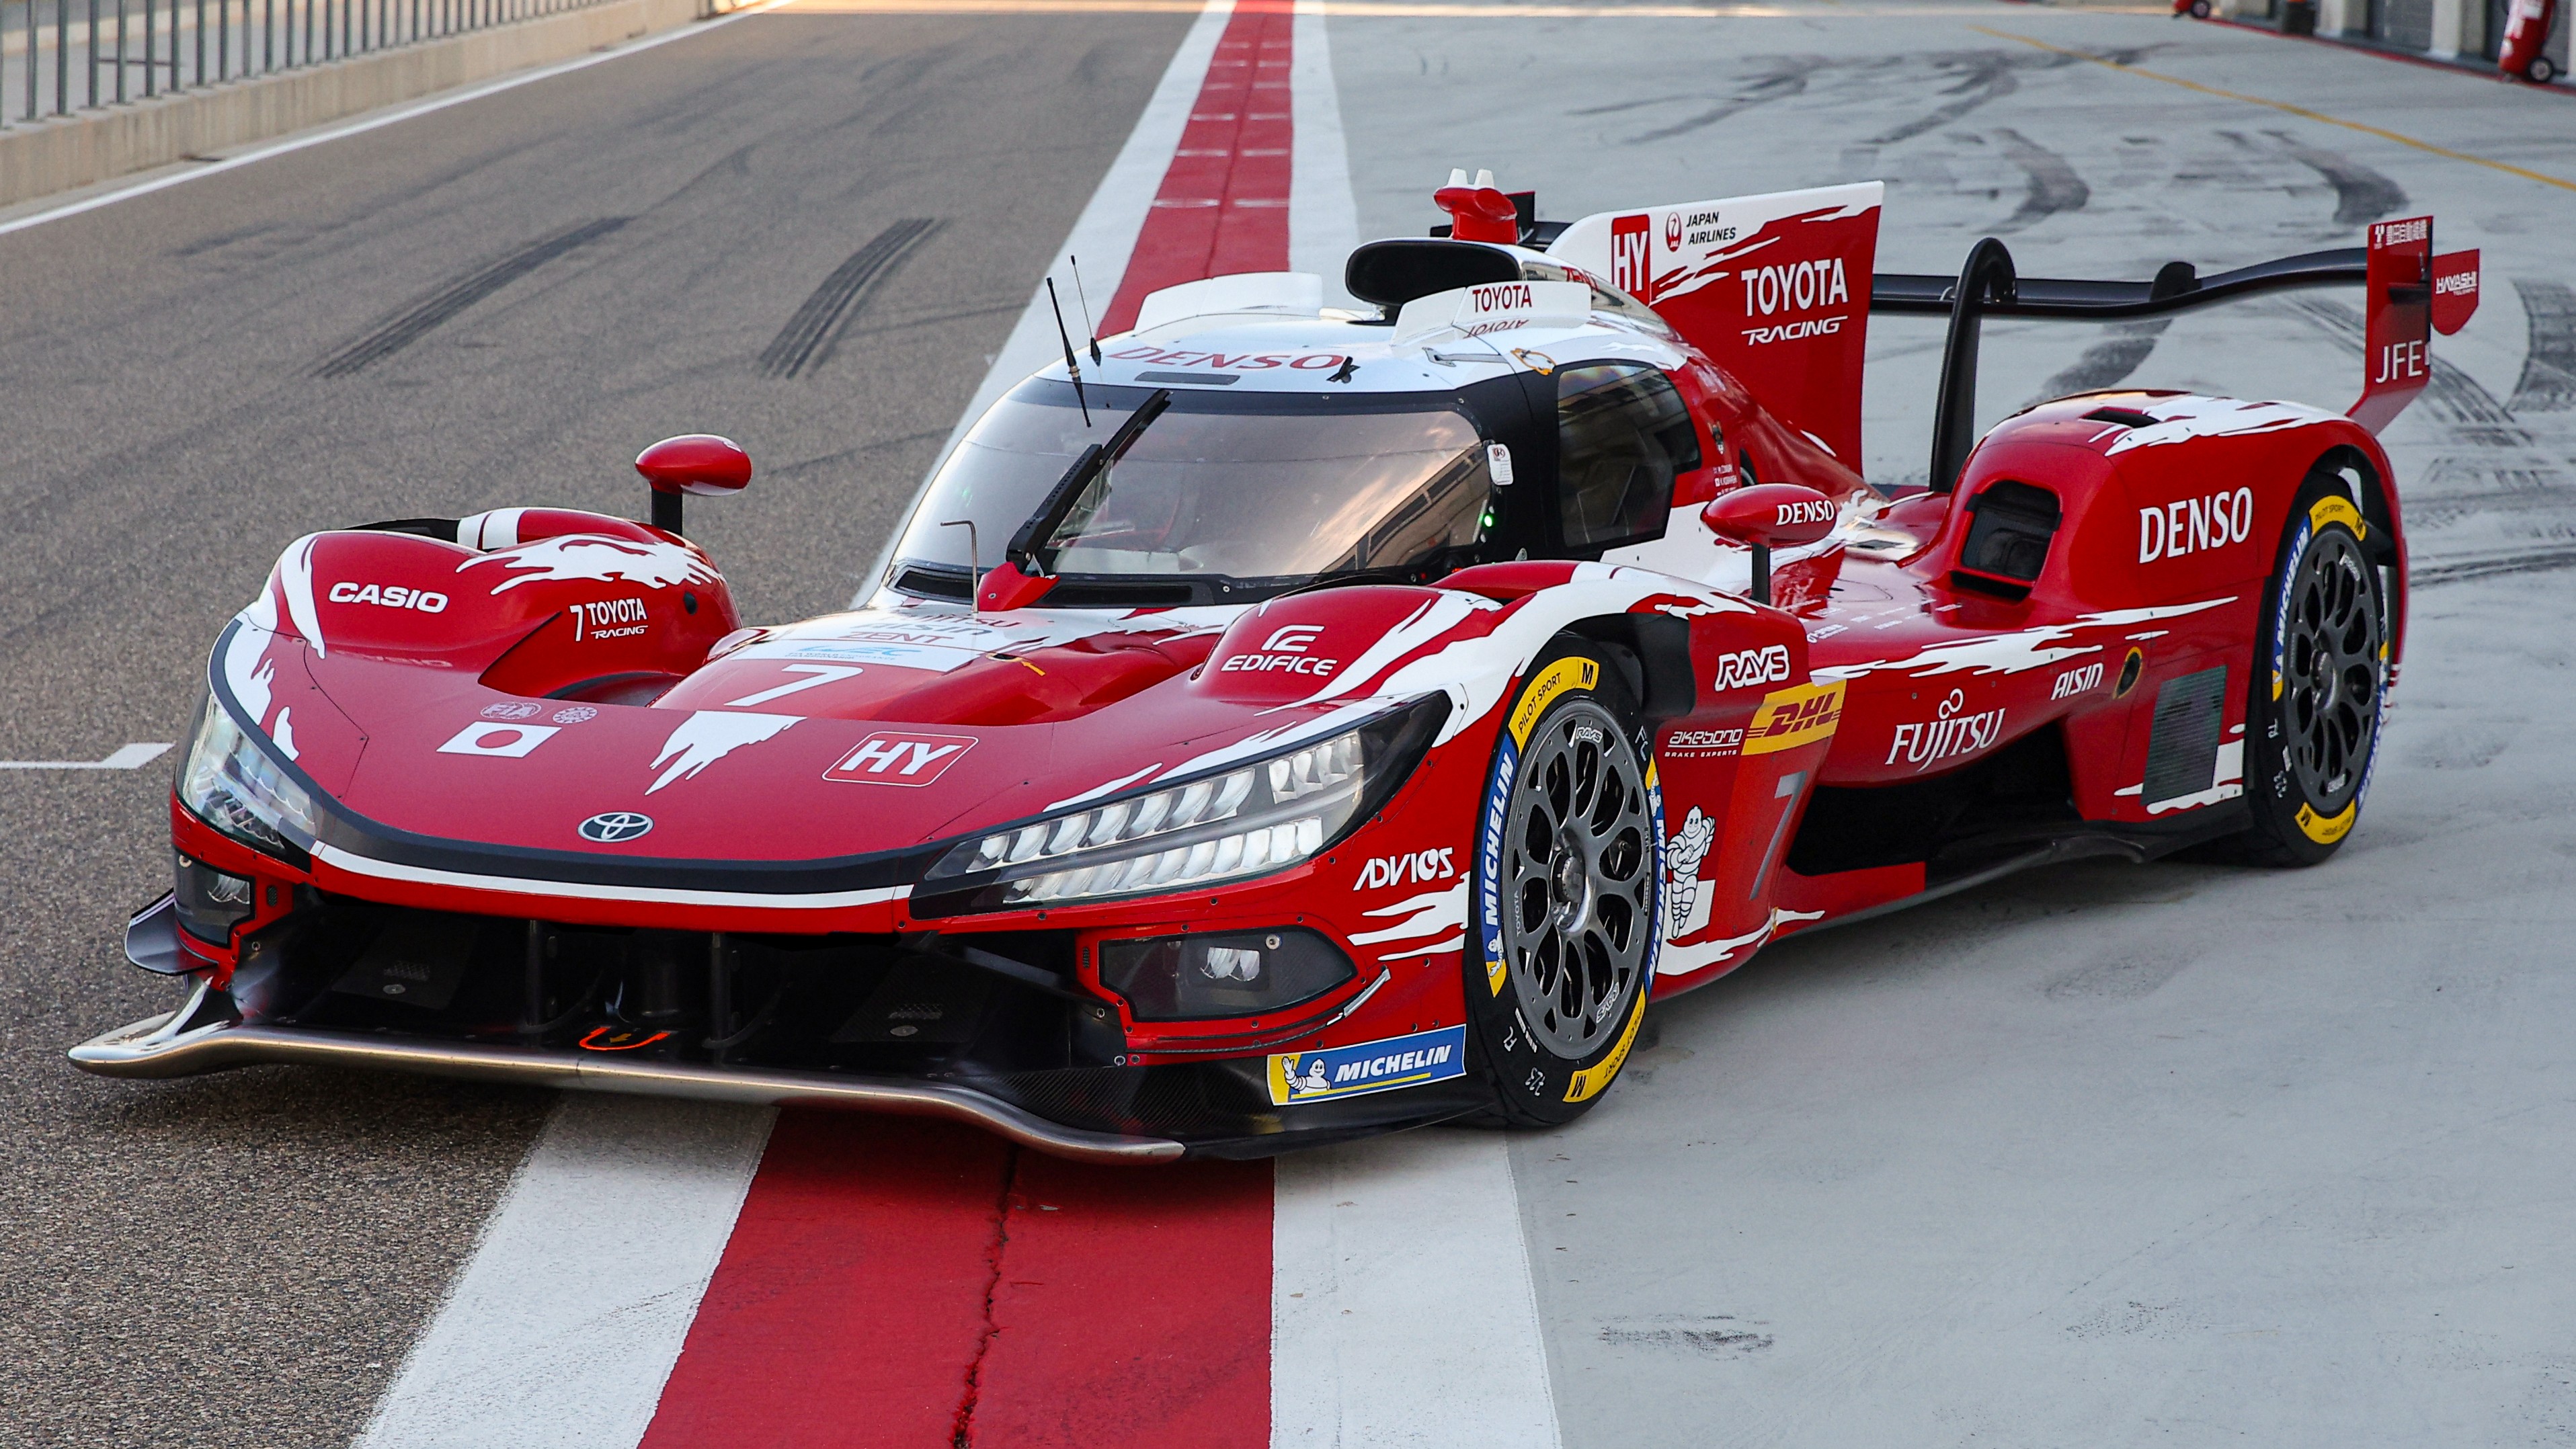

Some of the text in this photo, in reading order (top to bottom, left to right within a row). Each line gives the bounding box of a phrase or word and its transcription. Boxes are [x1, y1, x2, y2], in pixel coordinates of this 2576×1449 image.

[1686, 212, 1720, 228] JAPAN
[1688, 226, 1736, 245] AIRLINES
[1613, 231, 1648, 292] HY
[1472, 284, 1533, 313] TOYOTA
[1741, 257, 1849, 317] TOYOTA
[2436, 270, 2477, 294] HAYASHI
[1741, 315, 1849, 346] RACING
[1106, 345, 1344, 371] DENSO
[1775, 500, 1835, 526] DENSO
[2139, 487, 2253, 563] DENSO
[329, 582, 449, 613] CASIO
[2277, 526, 2309, 647] MICHELIN
[569, 604, 583, 642] 7
[586, 597, 647, 626] TOYOTA
[590, 625, 649, 639] RACING
[838, 631, 955, 643] ZENT
[1221, 655, 1338, 676] EDIFICE
[1581, 661, 1595, 686] M
[1714, 645, 1789, 692] RAYS
[2050, 663, 2104, 700] AISIN
[724, 663, 864, 707] 7
[1518, 672, 1562, 735] PILOT SPORT
[1763, 691, 1837, 737] DHL
[1575, 726, 1604, 745] RAYS
[1668, 728, 1744, 745] akebono
[1884, 703, 2007, 772] FUJITSU
[839, 740, 963, 776] HY
[1700, 749, 1738, 758] EXPERTS
[1484, 751, 1515, 927] MICHELIN
[1749, 770, 1808, 901] 7
[1513, 890, 1523, 938] TOYOTA
[1649, 819, 1666, 985] MICHELIN
[1334, 1044, 1452, 1083] MICHELIN
[1570, 1074, 1587, 1098] M
